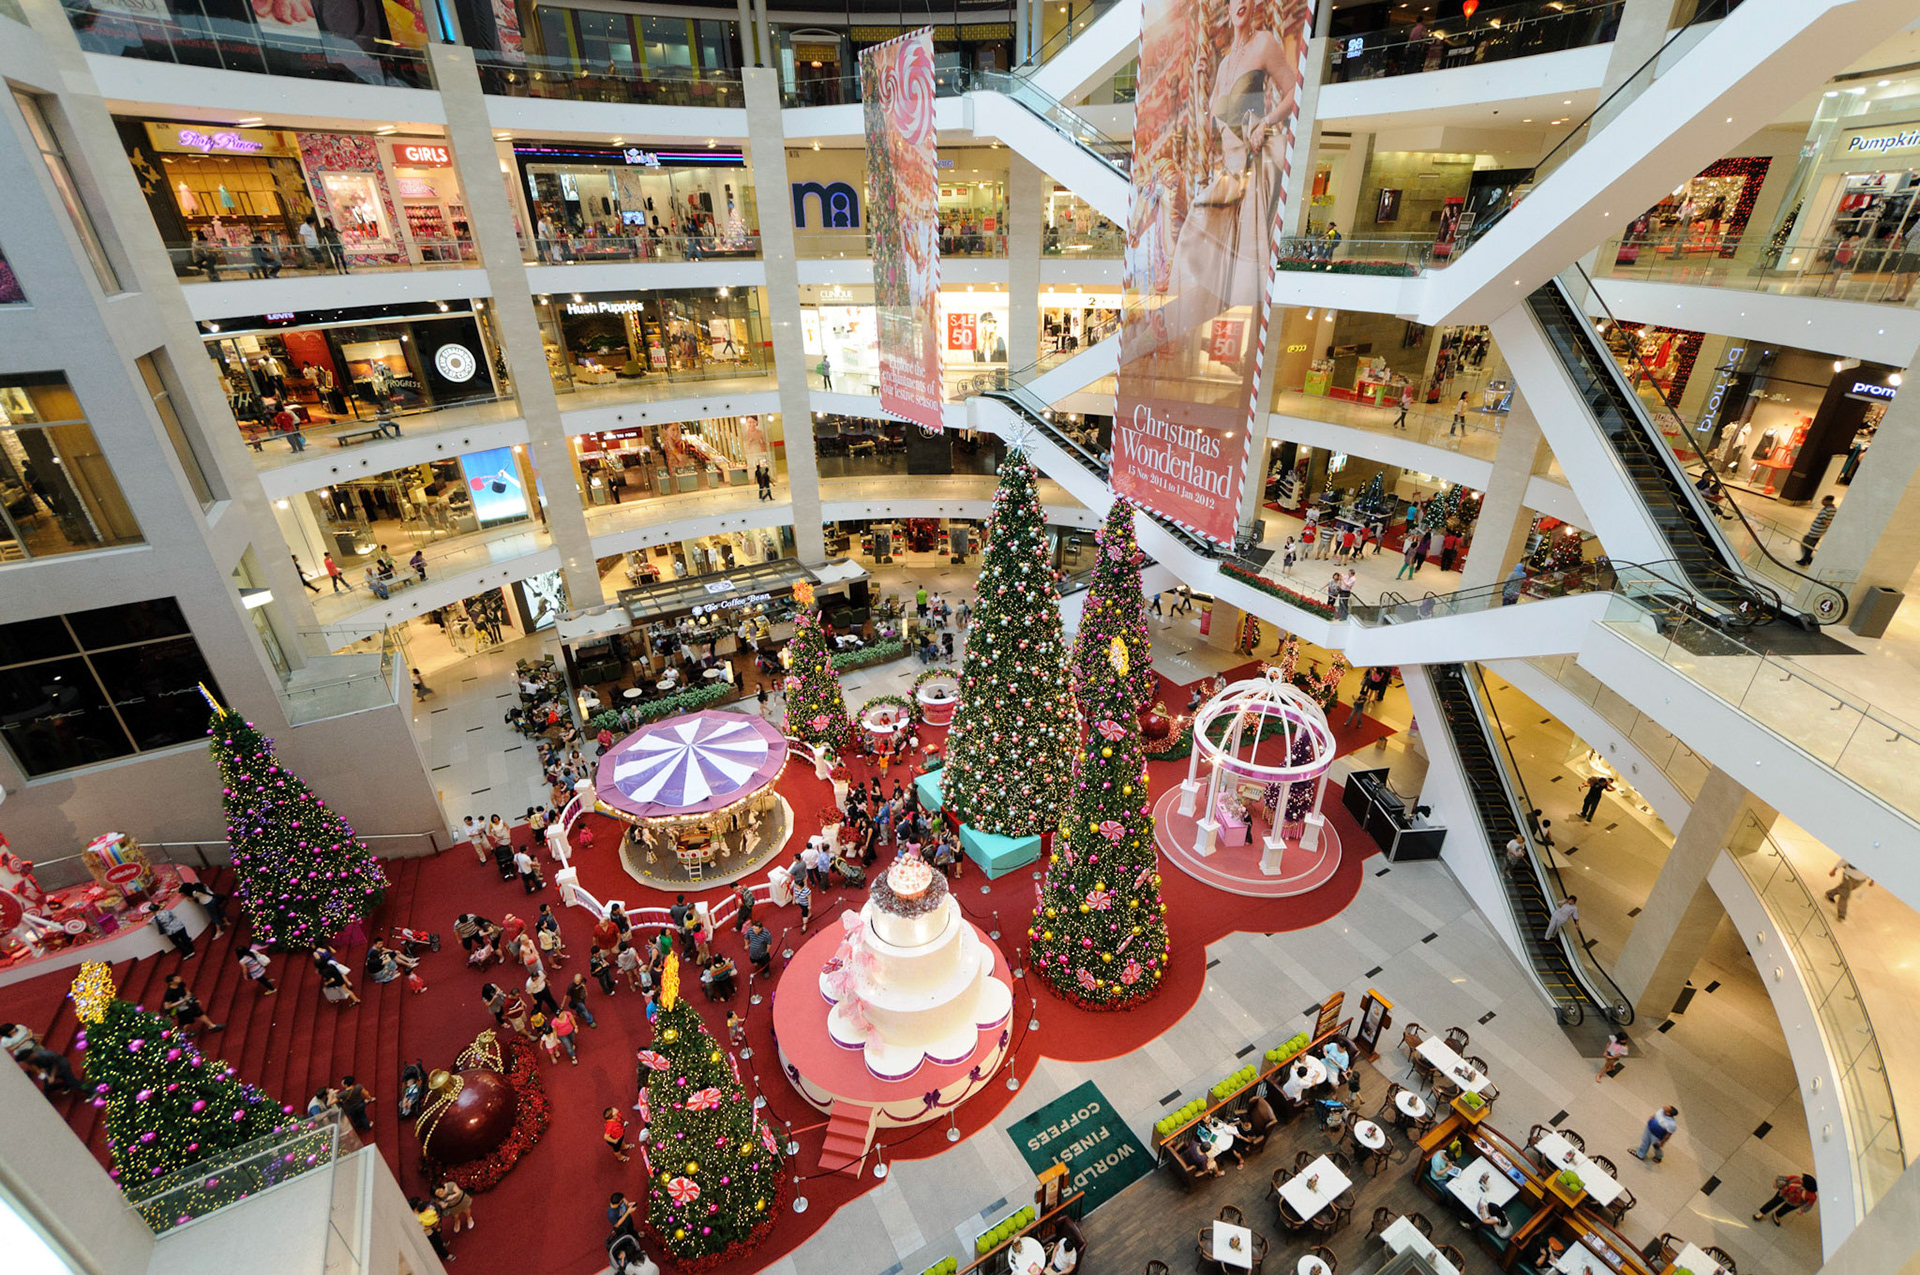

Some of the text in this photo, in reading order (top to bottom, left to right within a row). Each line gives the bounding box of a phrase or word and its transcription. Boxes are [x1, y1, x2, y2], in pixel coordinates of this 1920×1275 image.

[405, 147, 448, 162] GIRLS
[566, 301, 644, 315] Hush Puppies
[950, 315, 975, 326] SALE
[1213, 322, 1240, 336] SALE
[952, 329, 973, 346] 50
[1213, 338, 1237, 356] 50
[1697, 347, 1744, 432] promod
[916, 394, 939, 412] season
[1133, 404, 1221, 459] Christmas
[1120, 426, 1233, 499] Wonderland
[1128, 464, 1136, 475] 15
[1136, 467, 1148, 480] Nov
[1150, 473, 1167, 489] 2011
[1168, 482, 1176, 493] to
[1181, 486, 1193, 500] Jan
[1194, 492, 1215, 509] 2012
[721, 598, 745, 609] Coffee
[747, 593, 771, 602] Bean
[1738, 600, 1749, 613] 4
[1820, 600, 1830, 612] 4
[1027, 1102, 1101, 1152] COFFEES
[1061, 1144, 1135, 1198] WORLD'S
